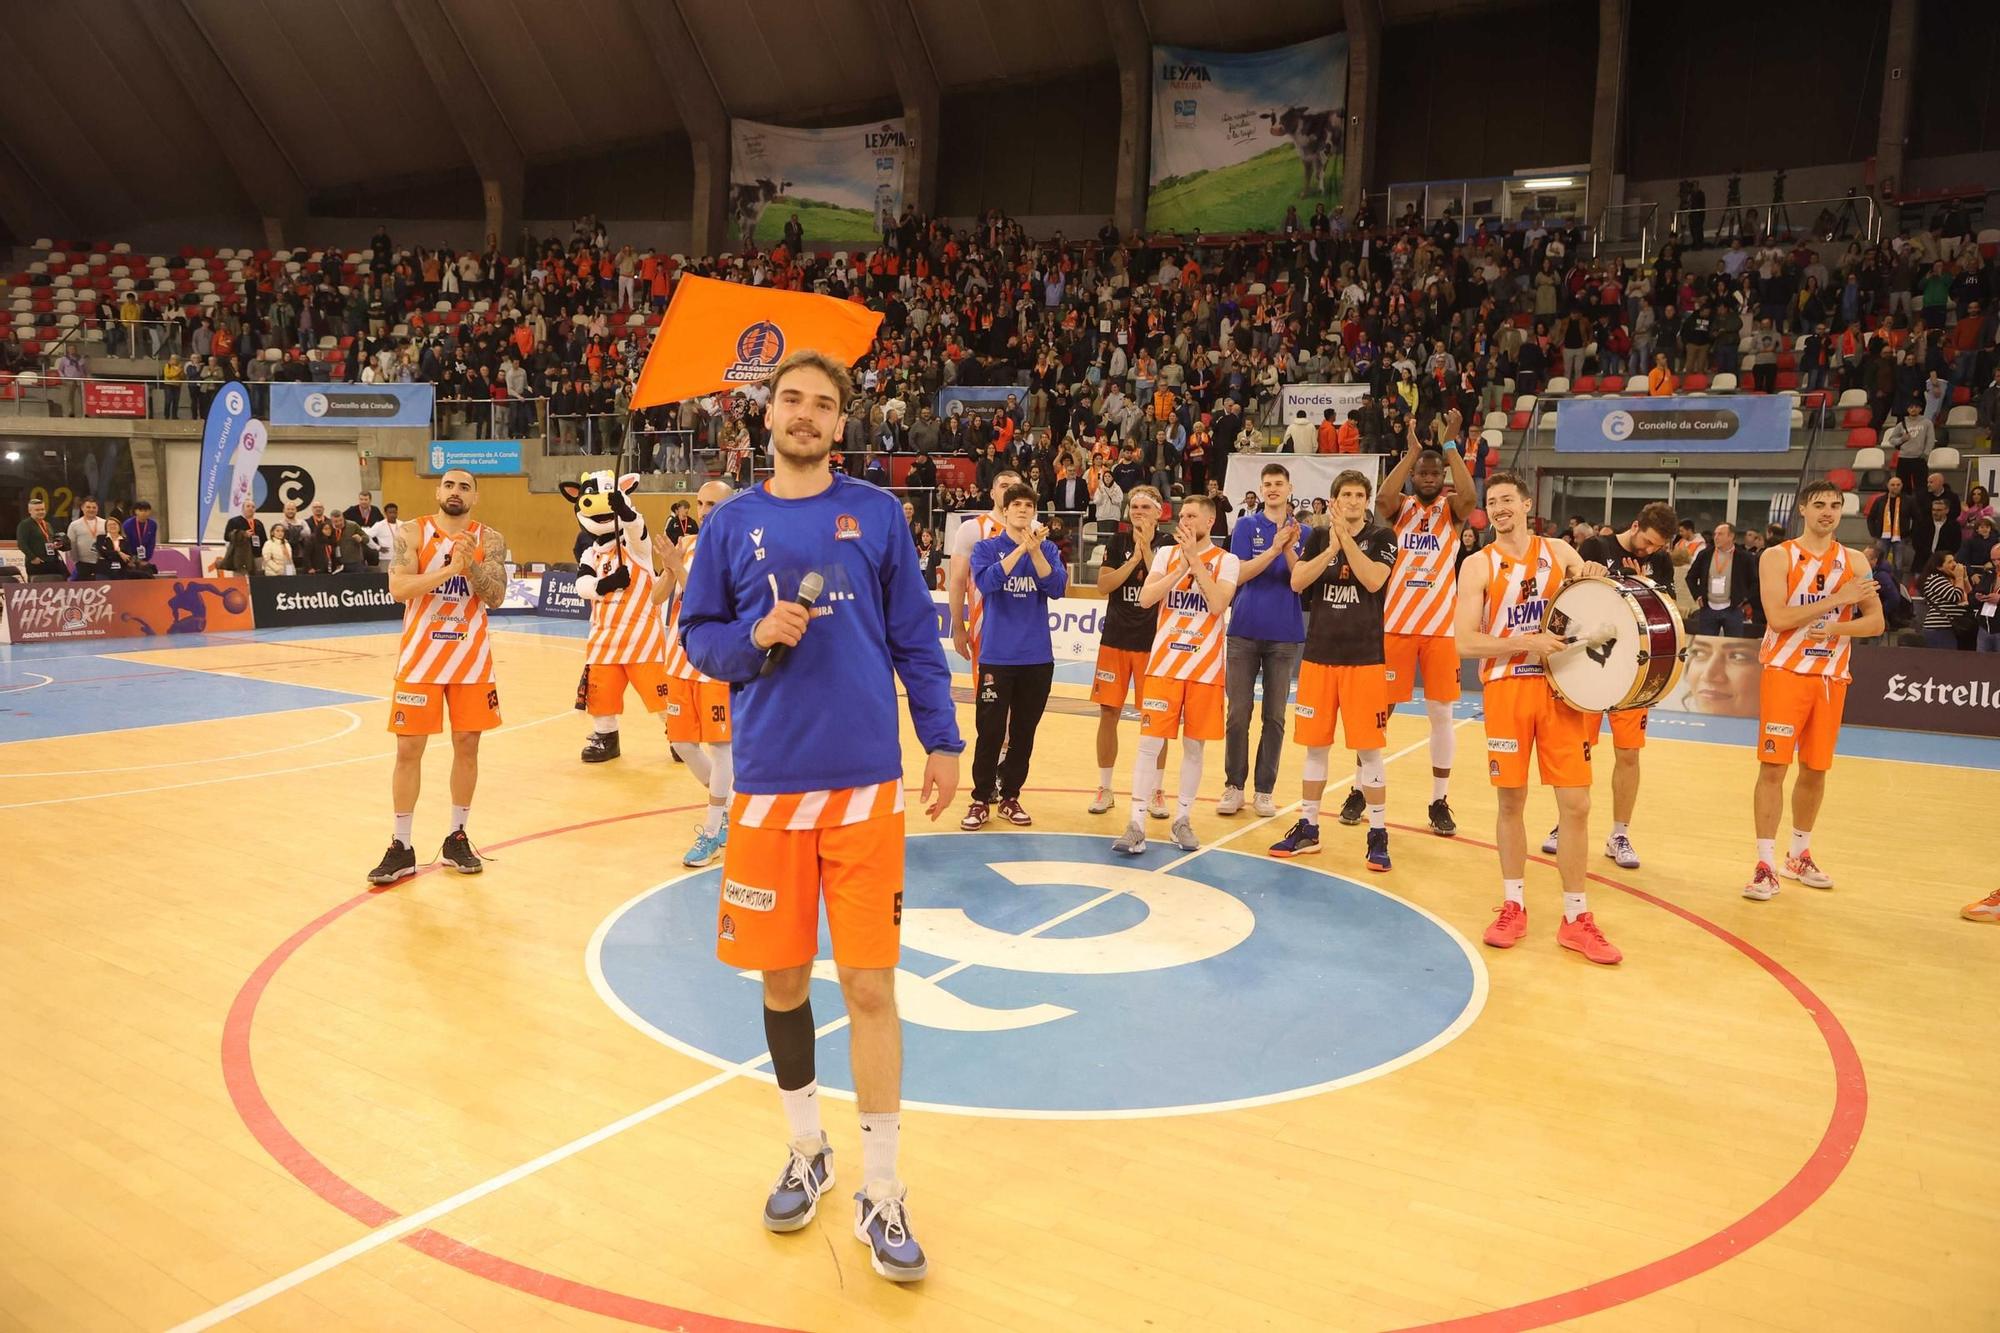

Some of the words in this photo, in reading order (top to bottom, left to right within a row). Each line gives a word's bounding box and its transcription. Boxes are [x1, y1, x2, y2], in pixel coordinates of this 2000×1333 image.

[1162, 64, 1212, 81] LEYMA
[864, 132, 908, 148] LEYMA
[1638, 420, 1678, 430] Concello
[1679, 420, 1692, 430] da
[1694, 419, 1729, 430] Coruña
[1404, 533, 1440, 552] LEYMA
[548, 578, 556, 593] É
[1520, 576, 1538, 600] 22
[1816, 574, 1825, 592] 9
[276, 592, 339, 610] Estrella
[341, 588, 395, 607] Galicia
[546, 594, 552, 604] é
[554, 594, 585, 608] Leyma
[1123, 586, 1142, 602] LEY
[1168, 590, 1208, 613] LEYMA
[1322, 584, 1360, 604] LEYMA
[656, 684, 668, 697] 96
[486, 690, 499, 710] 23
[712, 705, 726, 722] 30
